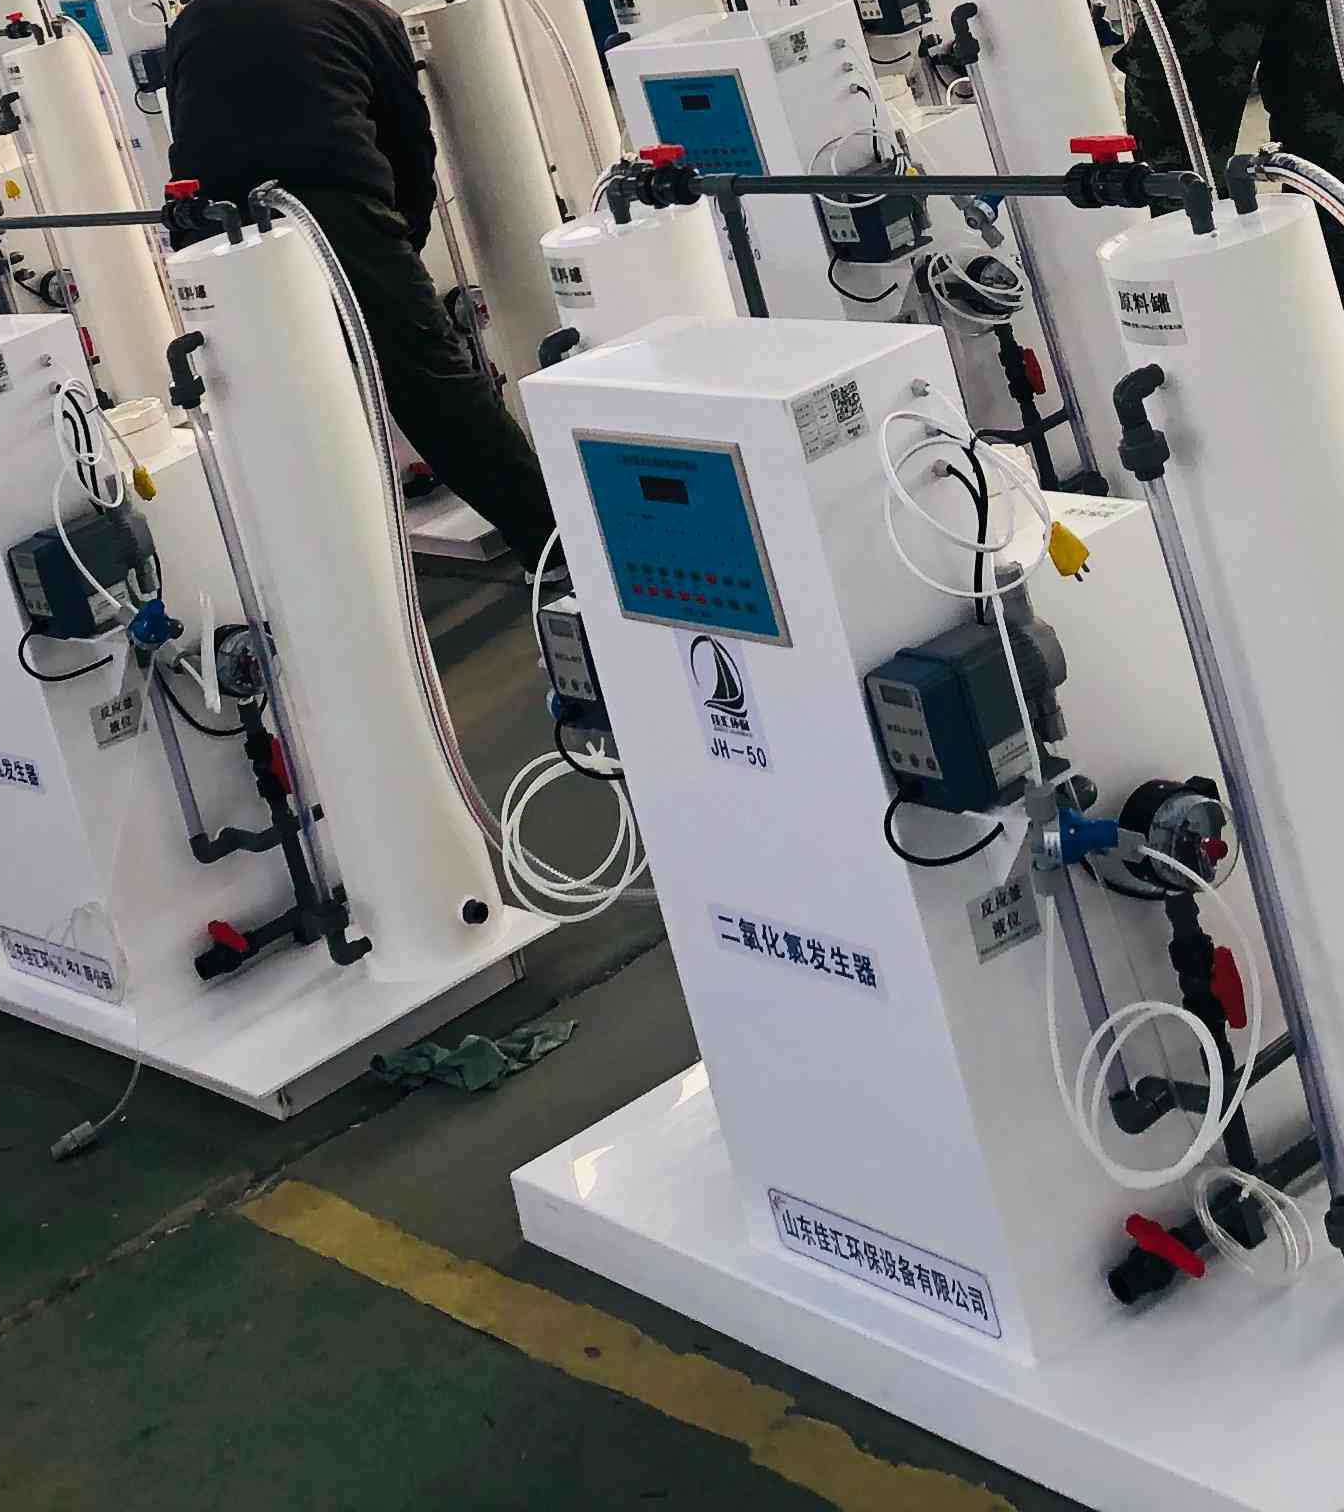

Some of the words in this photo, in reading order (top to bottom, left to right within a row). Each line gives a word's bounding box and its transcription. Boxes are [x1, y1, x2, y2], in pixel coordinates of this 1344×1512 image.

[1118, 290, 1171, 314] 原料罐
[717, 913, 878, 989] 二氧化氯发生器
[781, 1208, 989, 1321] 山东佳汇环保设备有限公司
